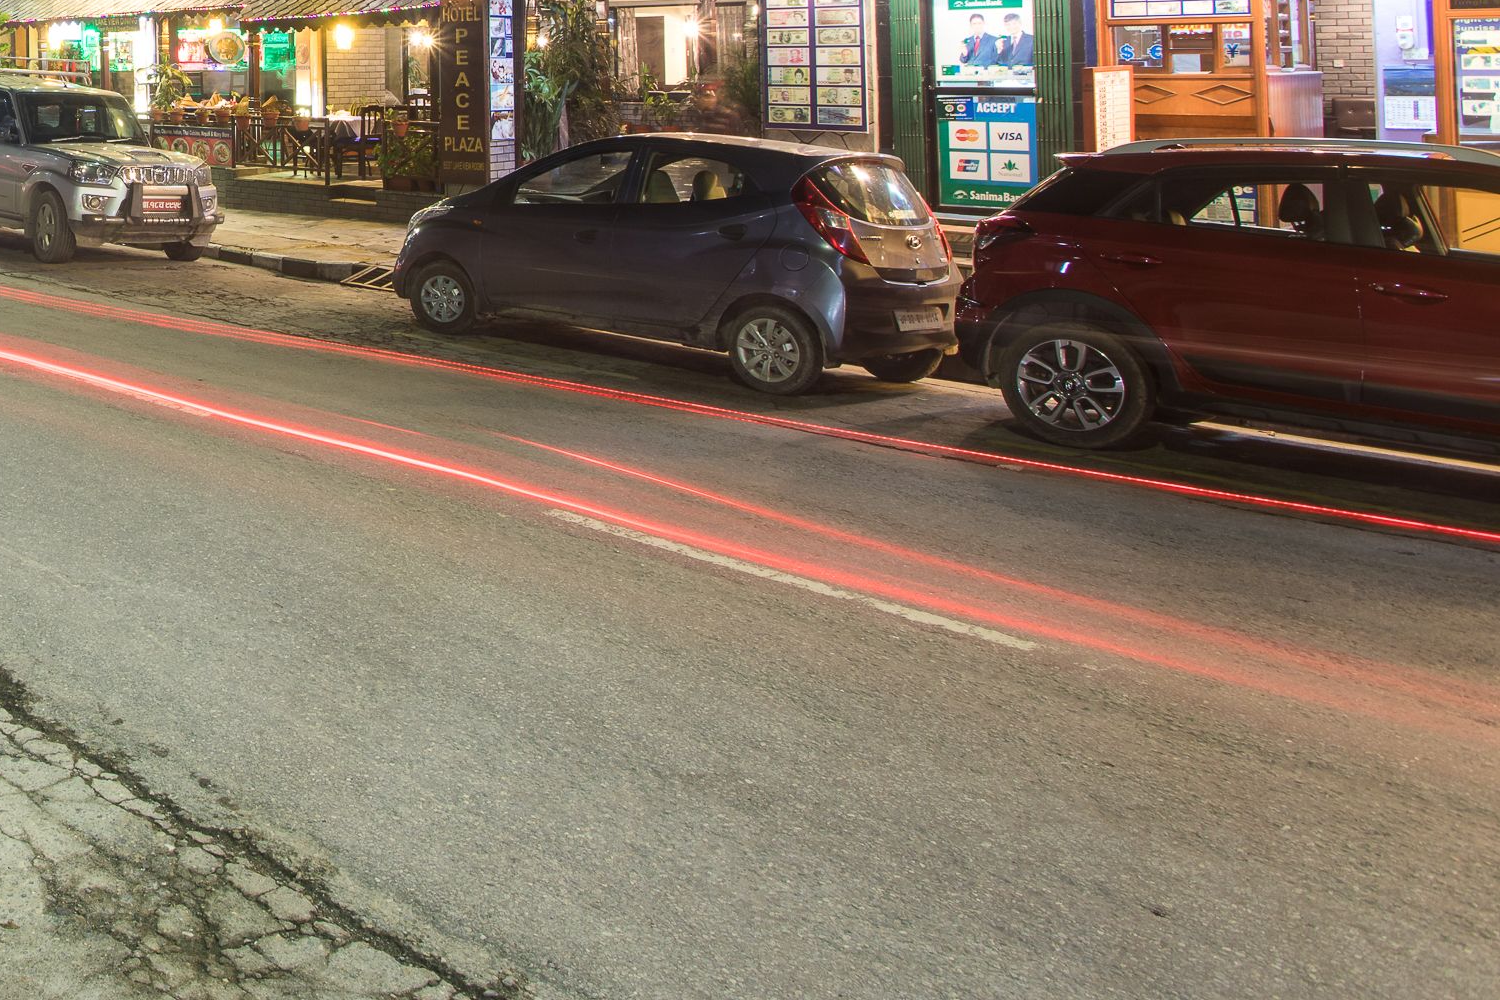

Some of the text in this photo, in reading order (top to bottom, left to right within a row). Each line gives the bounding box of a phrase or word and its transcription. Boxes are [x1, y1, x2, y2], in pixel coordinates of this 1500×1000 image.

[442, 5, 481, 23] HOTEL
[455, 28, 470, 131] PEACE
[976, 103, 1017, 113] ACCEPT
[997, 132, 1023, 141] VISA
[444, 136, 484, 153] PLAZA
[969, 190, 1002, 202] Sanima
